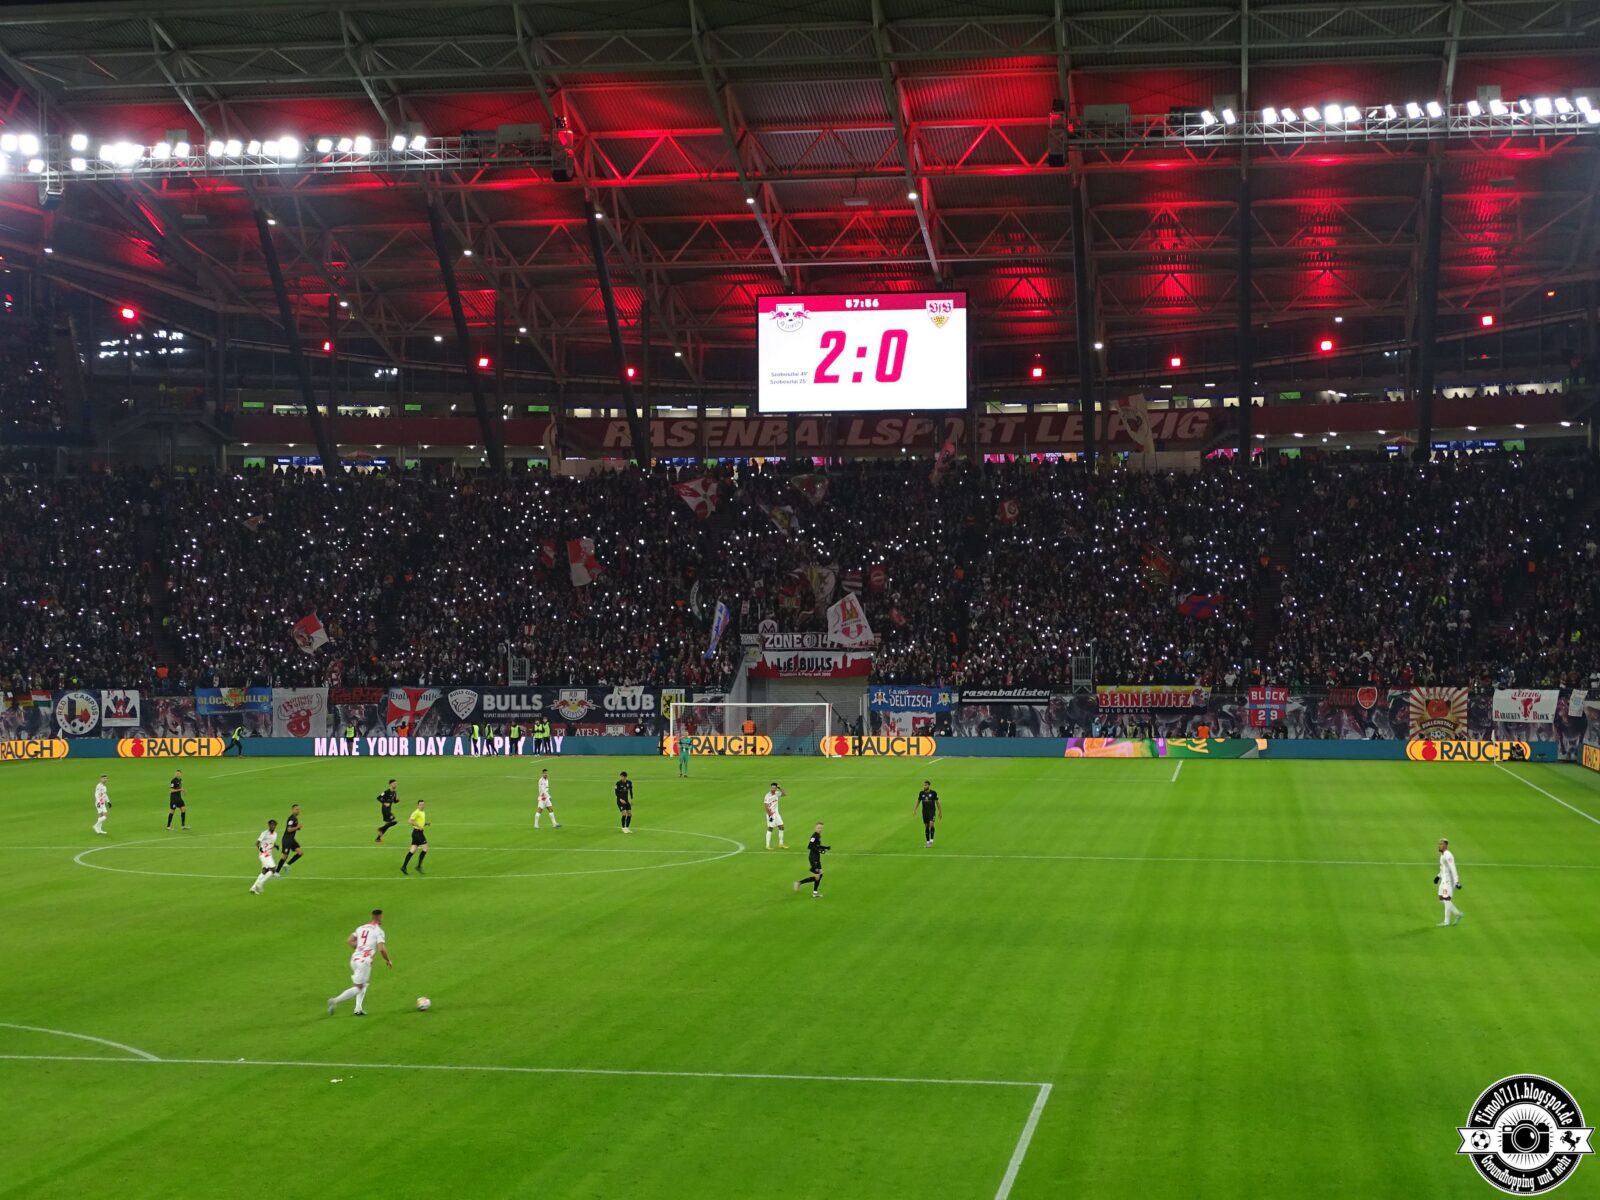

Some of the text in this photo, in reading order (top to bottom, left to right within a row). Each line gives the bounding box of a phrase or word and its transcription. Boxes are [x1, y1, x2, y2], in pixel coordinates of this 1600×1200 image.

[813, 329, 908, 384] 2:0
[603, 416, 1026, 448] RASENBALSPORT
[765, 635, 802, 648] ZONE
[800, 657, 832, 671] BULLS
[889, 694, 932, 708] DELITZSCH
[963, 687, 1050, 697] rasenballisten
[1098, 692, 1192, 708] BENNEWITZ
[1251, 690, 1285, 701] BLOCK
[74, 693, 98, 716] CAMPUS
[483, 693, 655, 711] BULLS CLUB
[555, 728, 599, 737] PIATES
[0, 740, 53, 759] RAUCH
[147, 738, 211, 756] RAUCH
[315, 737, 360, 756] MAKE
[366, 736, 409, 756] YOUR
[415, 736, 447, 756] DAY
[453, 736, 464, 755] A
[691, 736, 757, 754] RAUCH
[1440, 741, 1513, 760] RAUCH
[361, 930, 369, 945] 4
